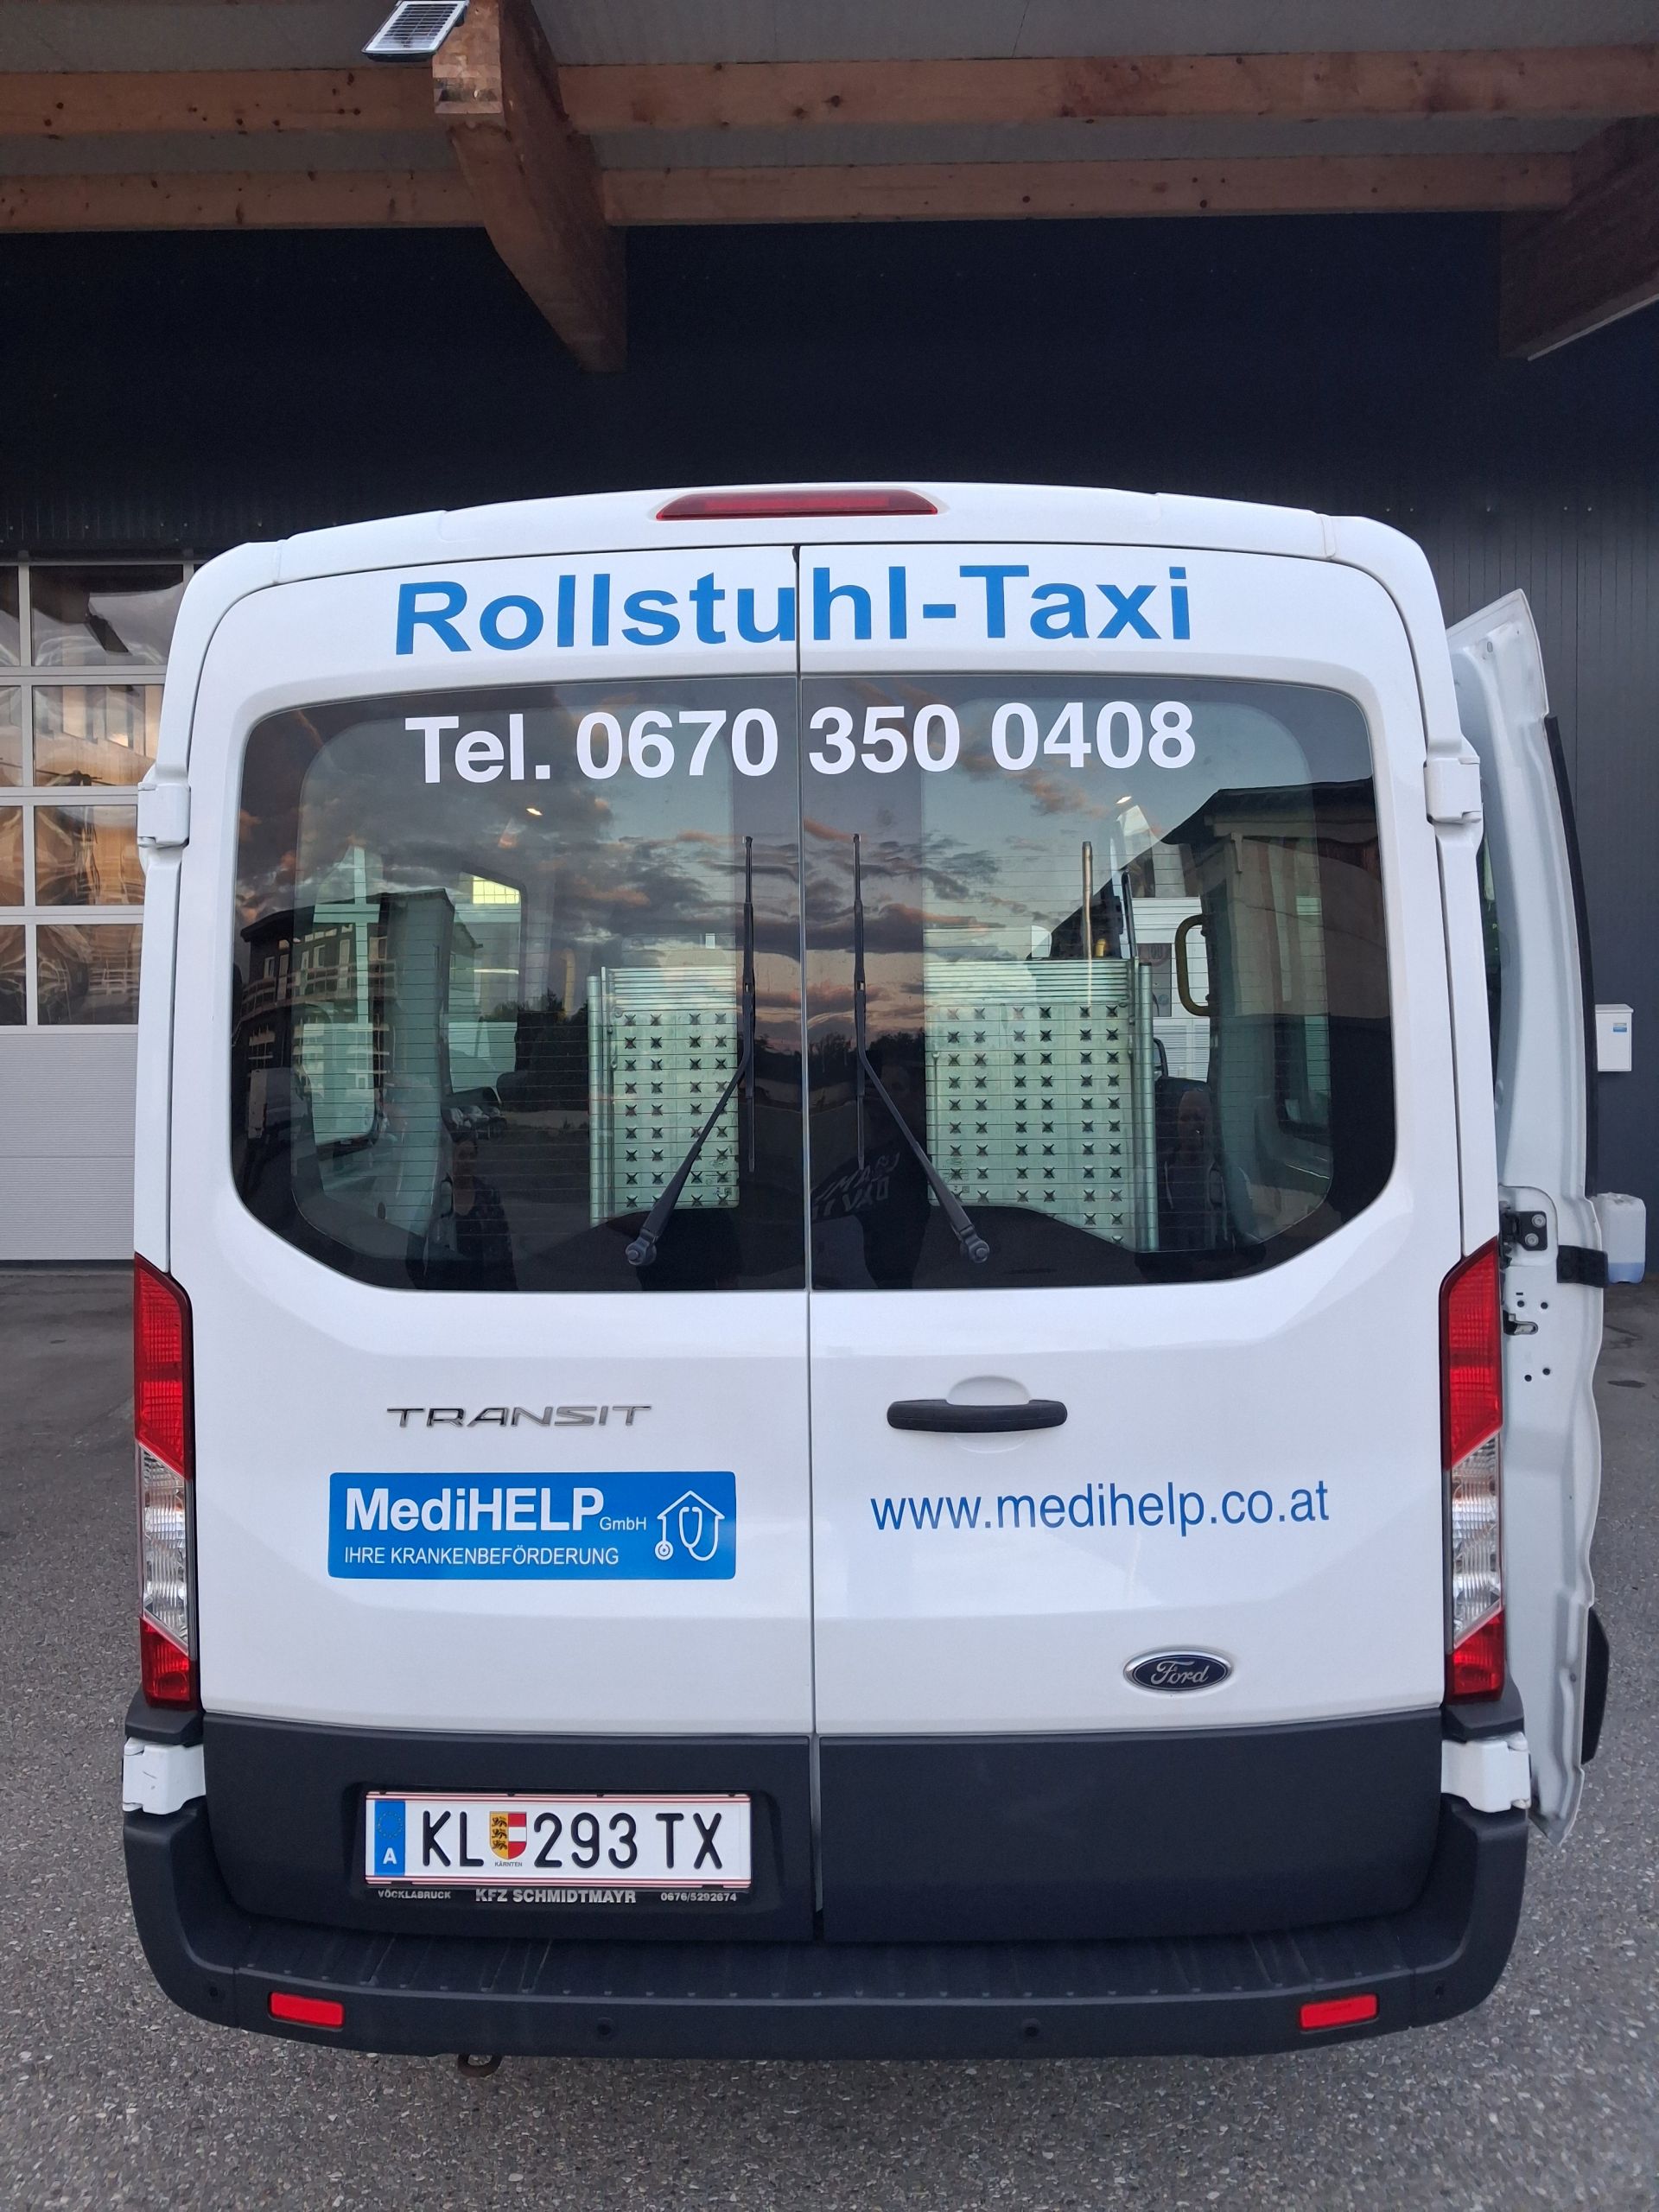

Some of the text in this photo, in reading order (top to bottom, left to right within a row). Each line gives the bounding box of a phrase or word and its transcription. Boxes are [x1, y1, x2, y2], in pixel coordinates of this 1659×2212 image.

[396, 564, 1191, 654] Rollstuhl-Taxi
[405, 701, 1196, 784] Tel. 0670 350 0408
[387, 1405, 652, 1427] TRANSIT
[346, 1487, 646, 1532] MediHELP GmbH
[871, 1480, 1329, 1537] www.medihelp.co.at
[345, 1545, 619, 1566] IHRE KRANKENBEFÖRDERUNG
[1150, 1660, 1209, 1685] Ford
[383, 1847, 397, 1865] A
[423, 1810, 722, 1870] KL 293 TX
[378, 1888, 737, 1904] VÖCKLABRUCK KFZ SCHMIDTMAYR 0676/5292674
